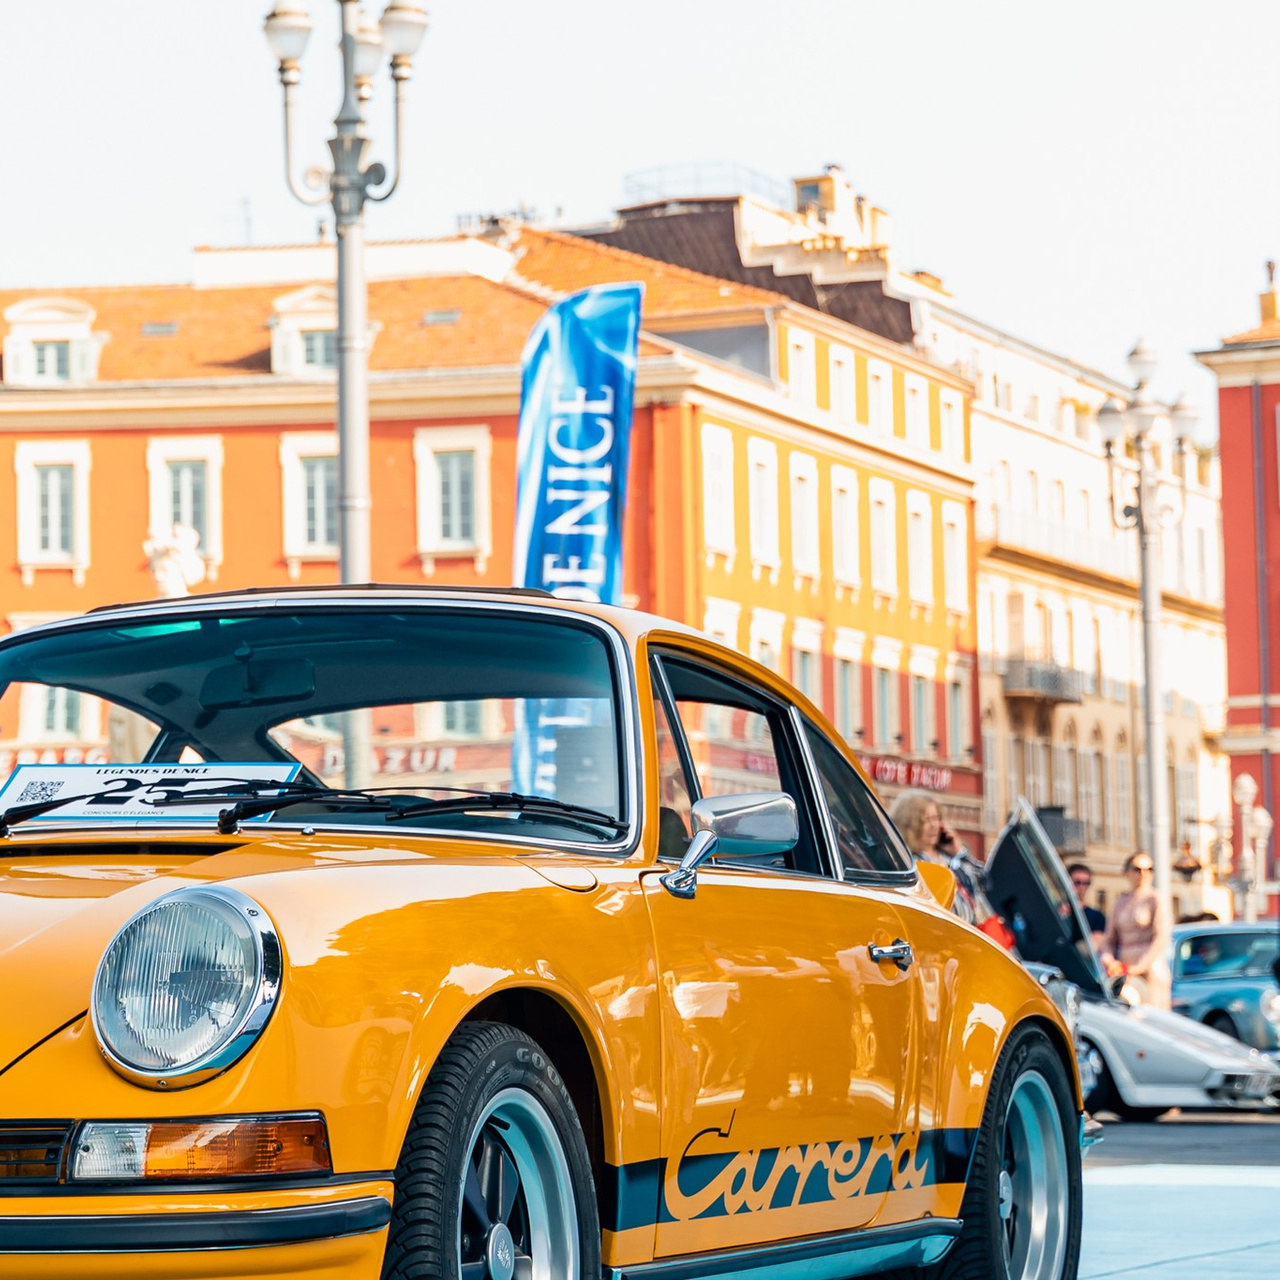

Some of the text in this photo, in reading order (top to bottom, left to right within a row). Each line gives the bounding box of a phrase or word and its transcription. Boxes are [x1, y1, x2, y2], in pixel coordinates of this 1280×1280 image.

[544, 385, 615, 536] NICE
[162, 767, 179, 775] DE
[181, 767, 210, 775] NICE
[664, 1109, 929, 1220] Carrera
